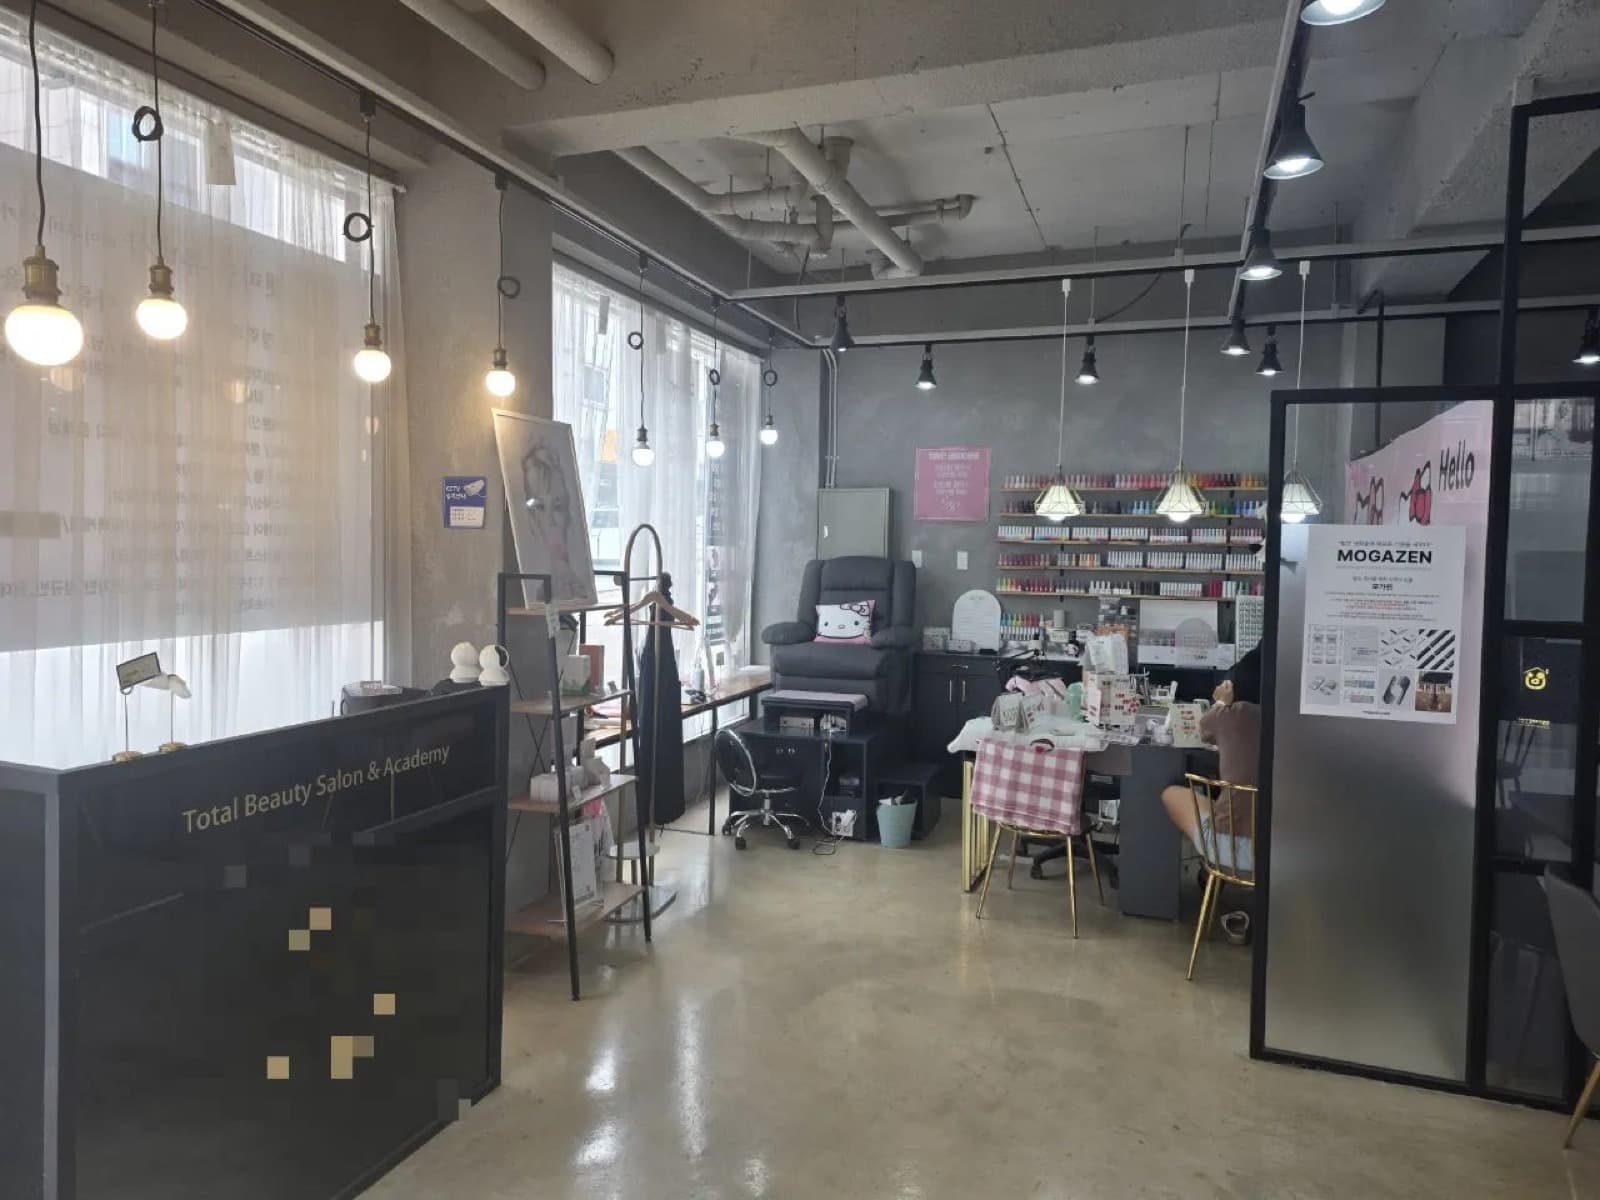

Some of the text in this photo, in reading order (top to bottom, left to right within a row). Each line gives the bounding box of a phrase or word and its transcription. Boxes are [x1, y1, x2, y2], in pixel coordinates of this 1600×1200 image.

[1438, 439, 1475, 492] Hello
[1337, 549, 1432, 565] MOGAZEN
[182, 745, 450, 833] Total Beauty Salon & Academy
